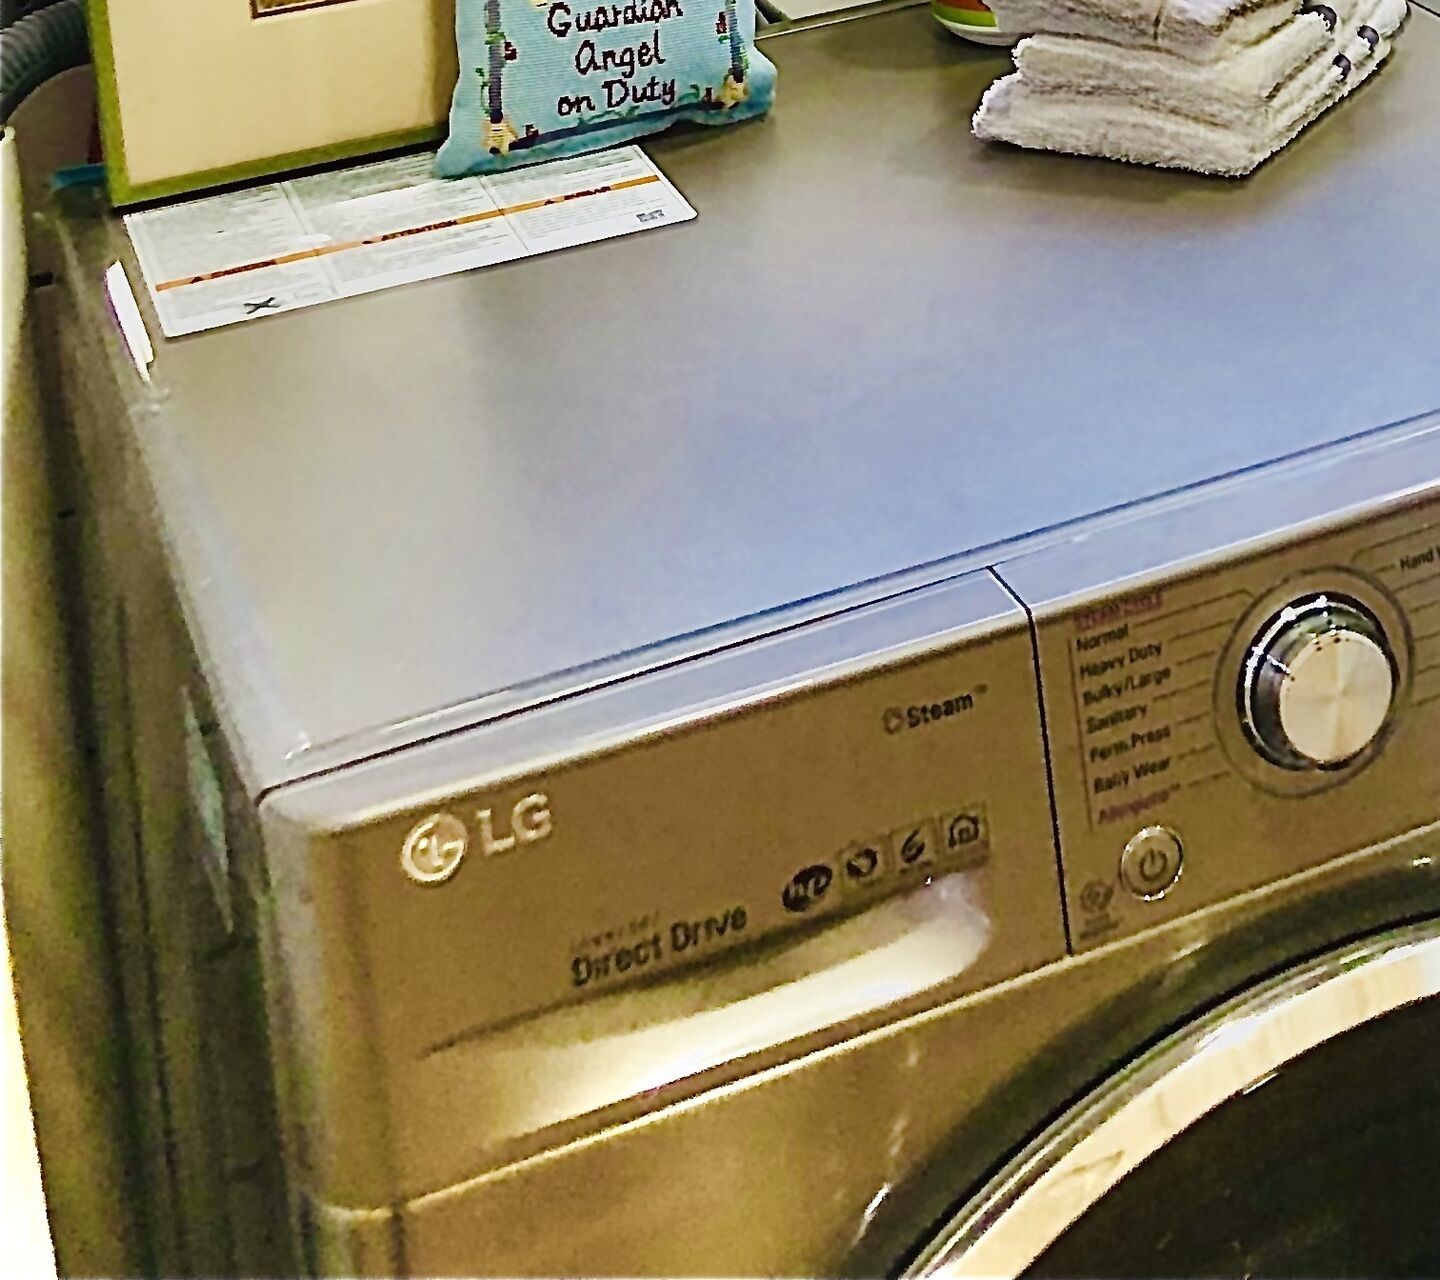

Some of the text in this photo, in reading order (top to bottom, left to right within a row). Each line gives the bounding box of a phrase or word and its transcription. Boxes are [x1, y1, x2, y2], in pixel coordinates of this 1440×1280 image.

[575, 30, 666, 78] Angel
[557, 75, 676, 117] on Duty
[1400, 548, 1434, 571] Hand
[1076, 623, 1129, 653] Normal
[1080, 641, 1163, 680] Heavy Duty
[1083, 666, 1172, 706] Bulky/Large
[907, 693, 974, 729] Steam
[1087, 704, 1148, 735] Sanitary
[1133, 755, 1172, 780] Wear
[476, 793, 552, 857] LG
[571, 933, 663, 987] Direct
[670, 905, 748, 953] Drive
